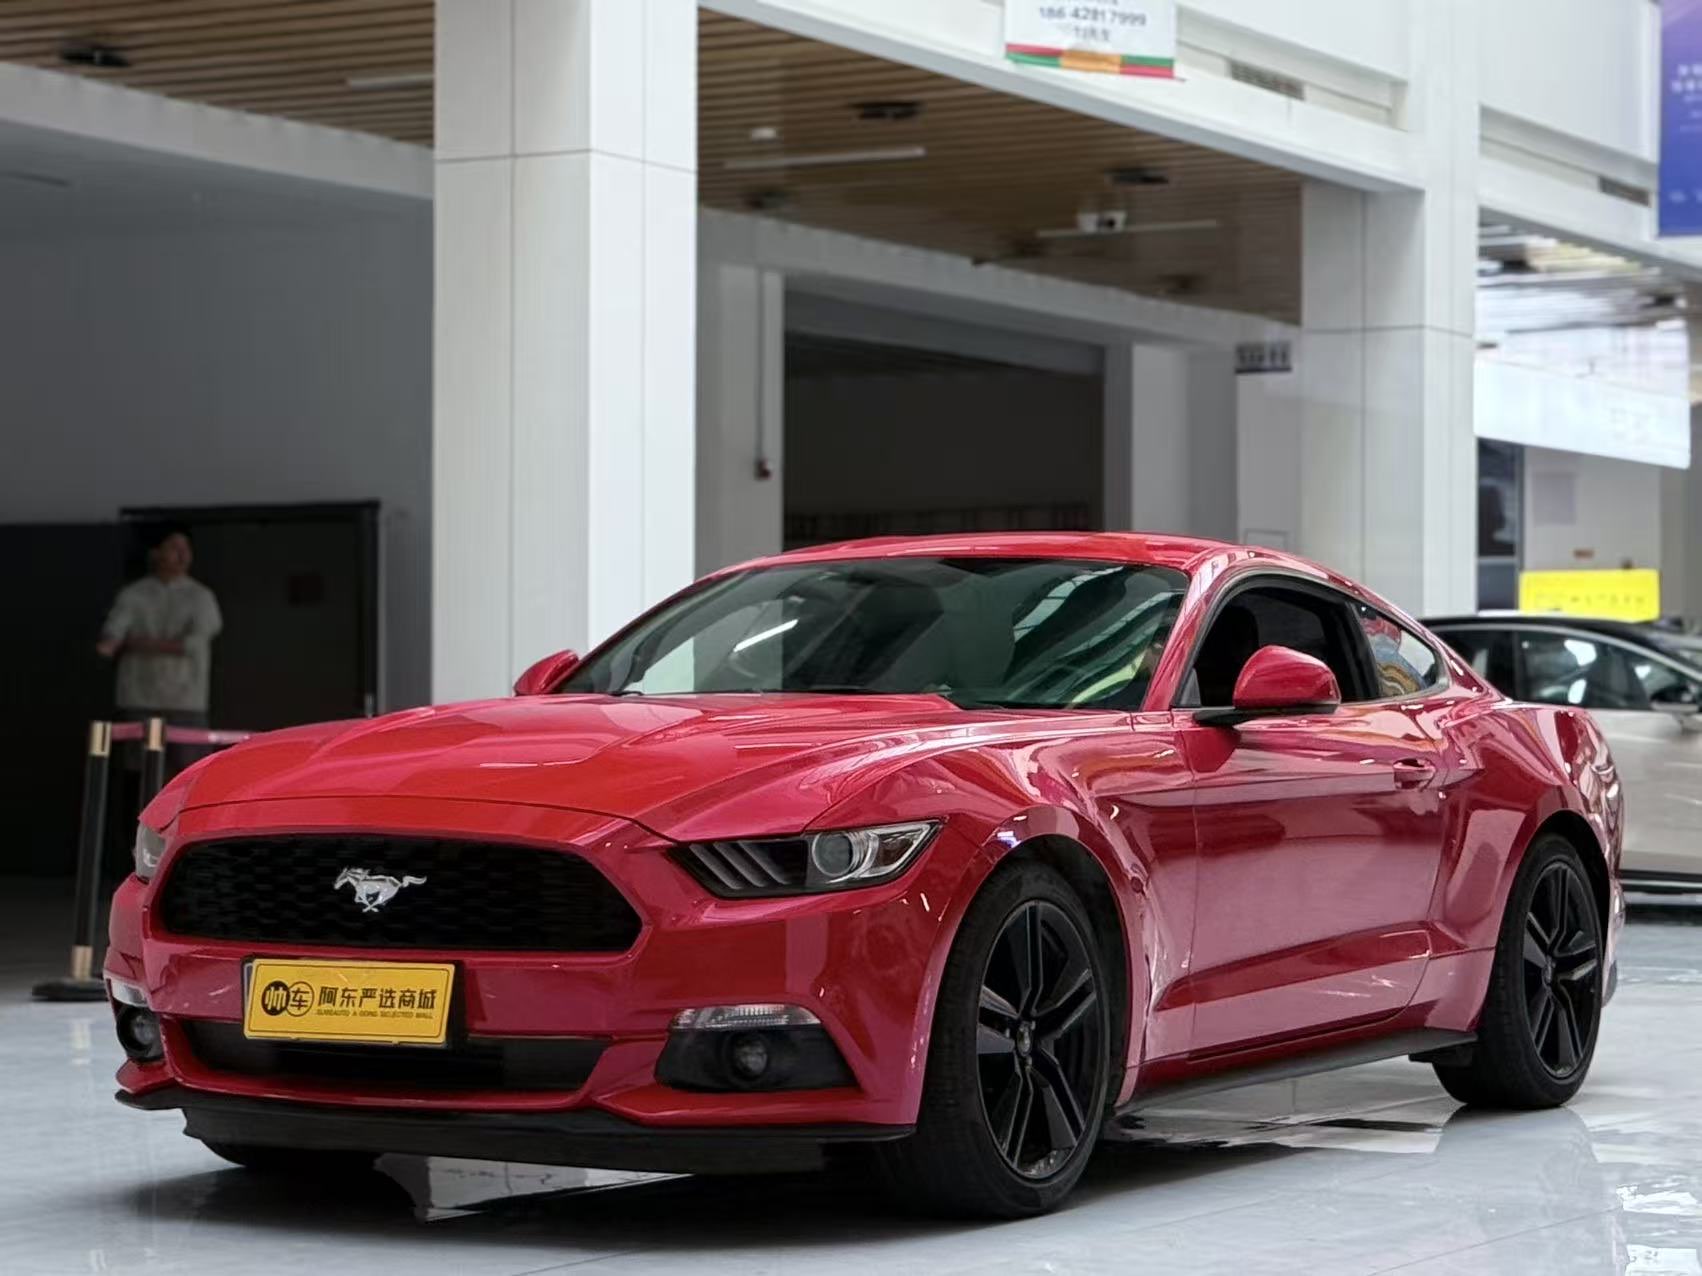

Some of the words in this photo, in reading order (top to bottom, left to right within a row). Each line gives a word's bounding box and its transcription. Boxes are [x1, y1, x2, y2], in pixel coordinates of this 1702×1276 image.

[264, 985, 310, 1011] 帅车
[317, 985, 437, 1010] 阿东严选商城
